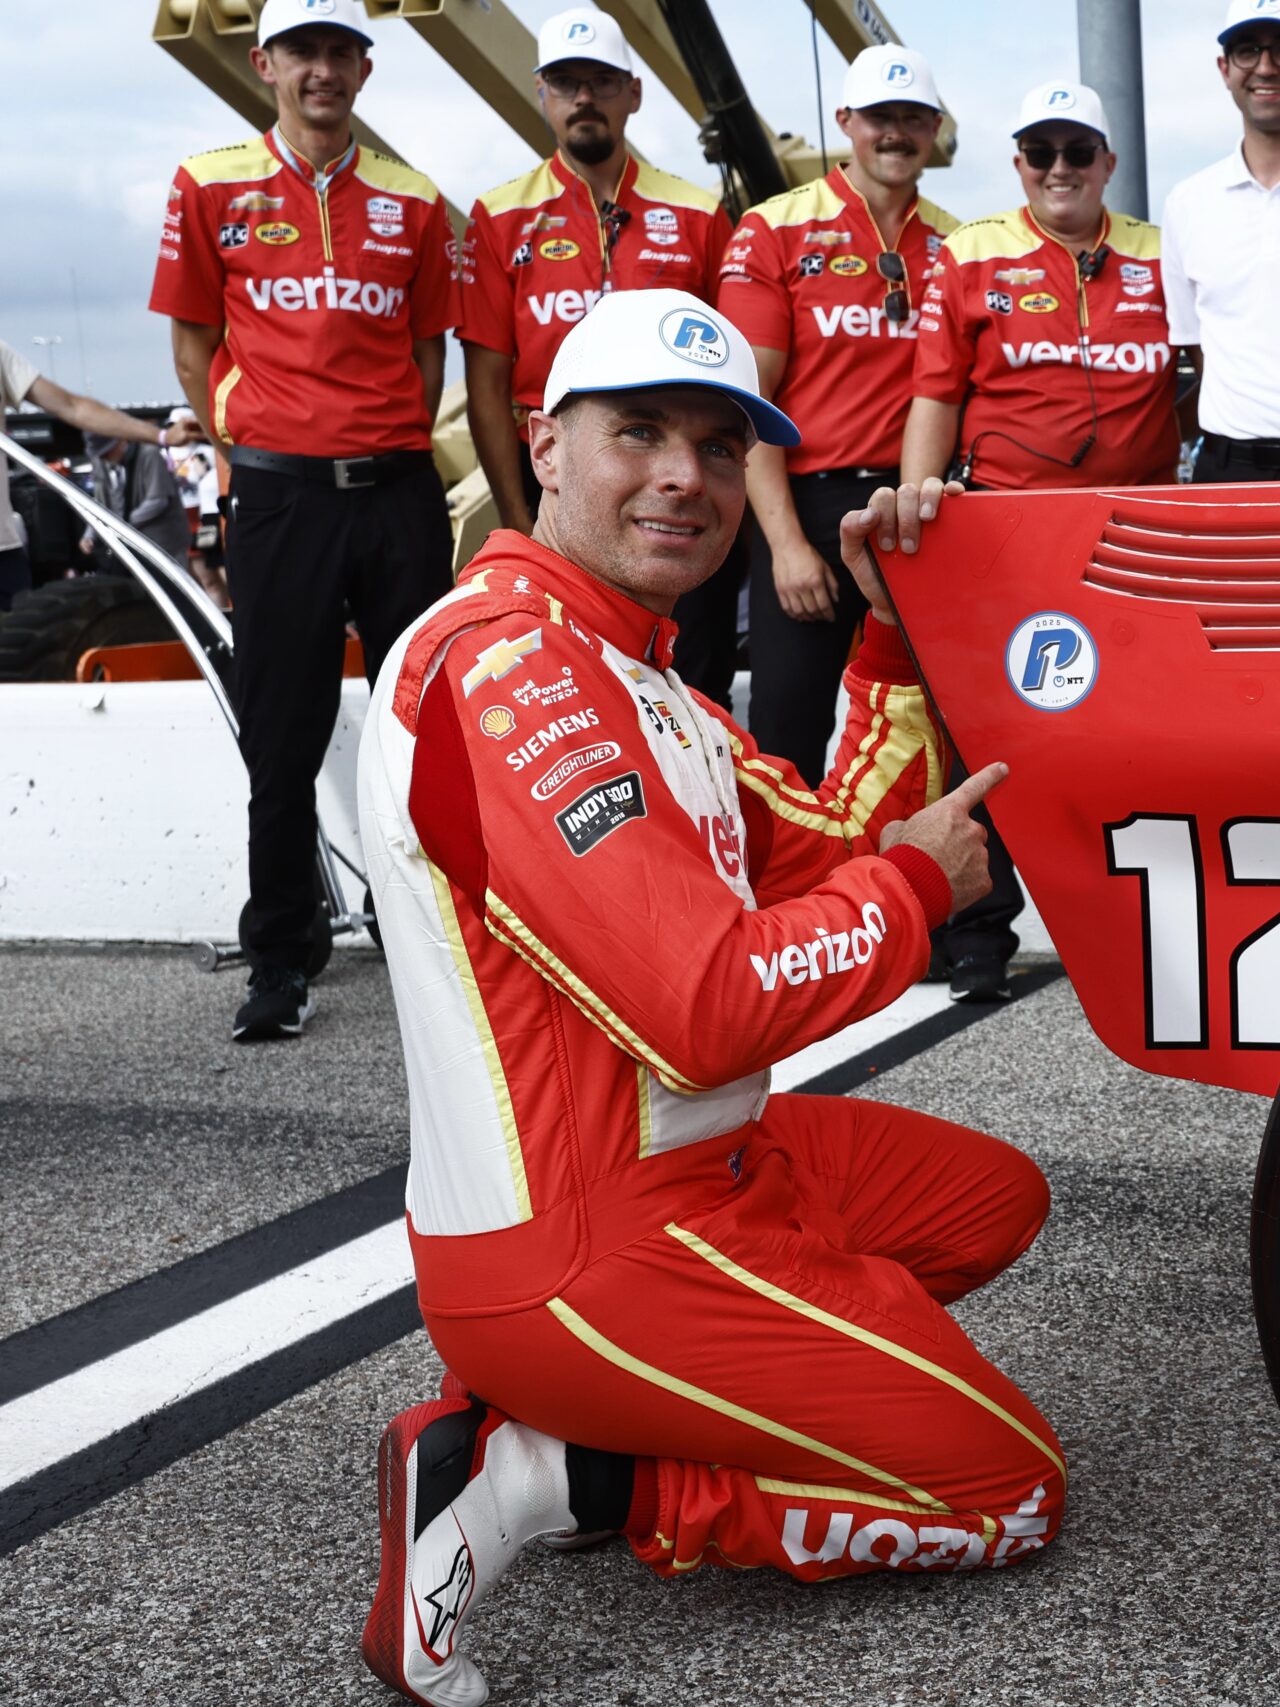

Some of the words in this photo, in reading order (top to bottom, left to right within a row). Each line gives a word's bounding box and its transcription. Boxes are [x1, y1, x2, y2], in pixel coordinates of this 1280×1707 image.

[261, 228, 294, 239] PENNZOIL
[362, 240, 412, 256] Snap-on
[638, 249, 691, 264] Snap-on
[246, 266, 404, 318] verizon
[1002, 336, 1171, 373] verizon
[1035, 619, 1061, 628] 2025
[512, 680, 537, 700] Shell
[517, 677, 574, 707] V-Power
[1067, 677, 1085, 685] NTT
[506, 708, 600, 772] SIEMENS
[541, 746, 613, 795] FREIGHTLINER
[564, 791, 609, 834] INDY
[749, 901, 888, 992] verizon
